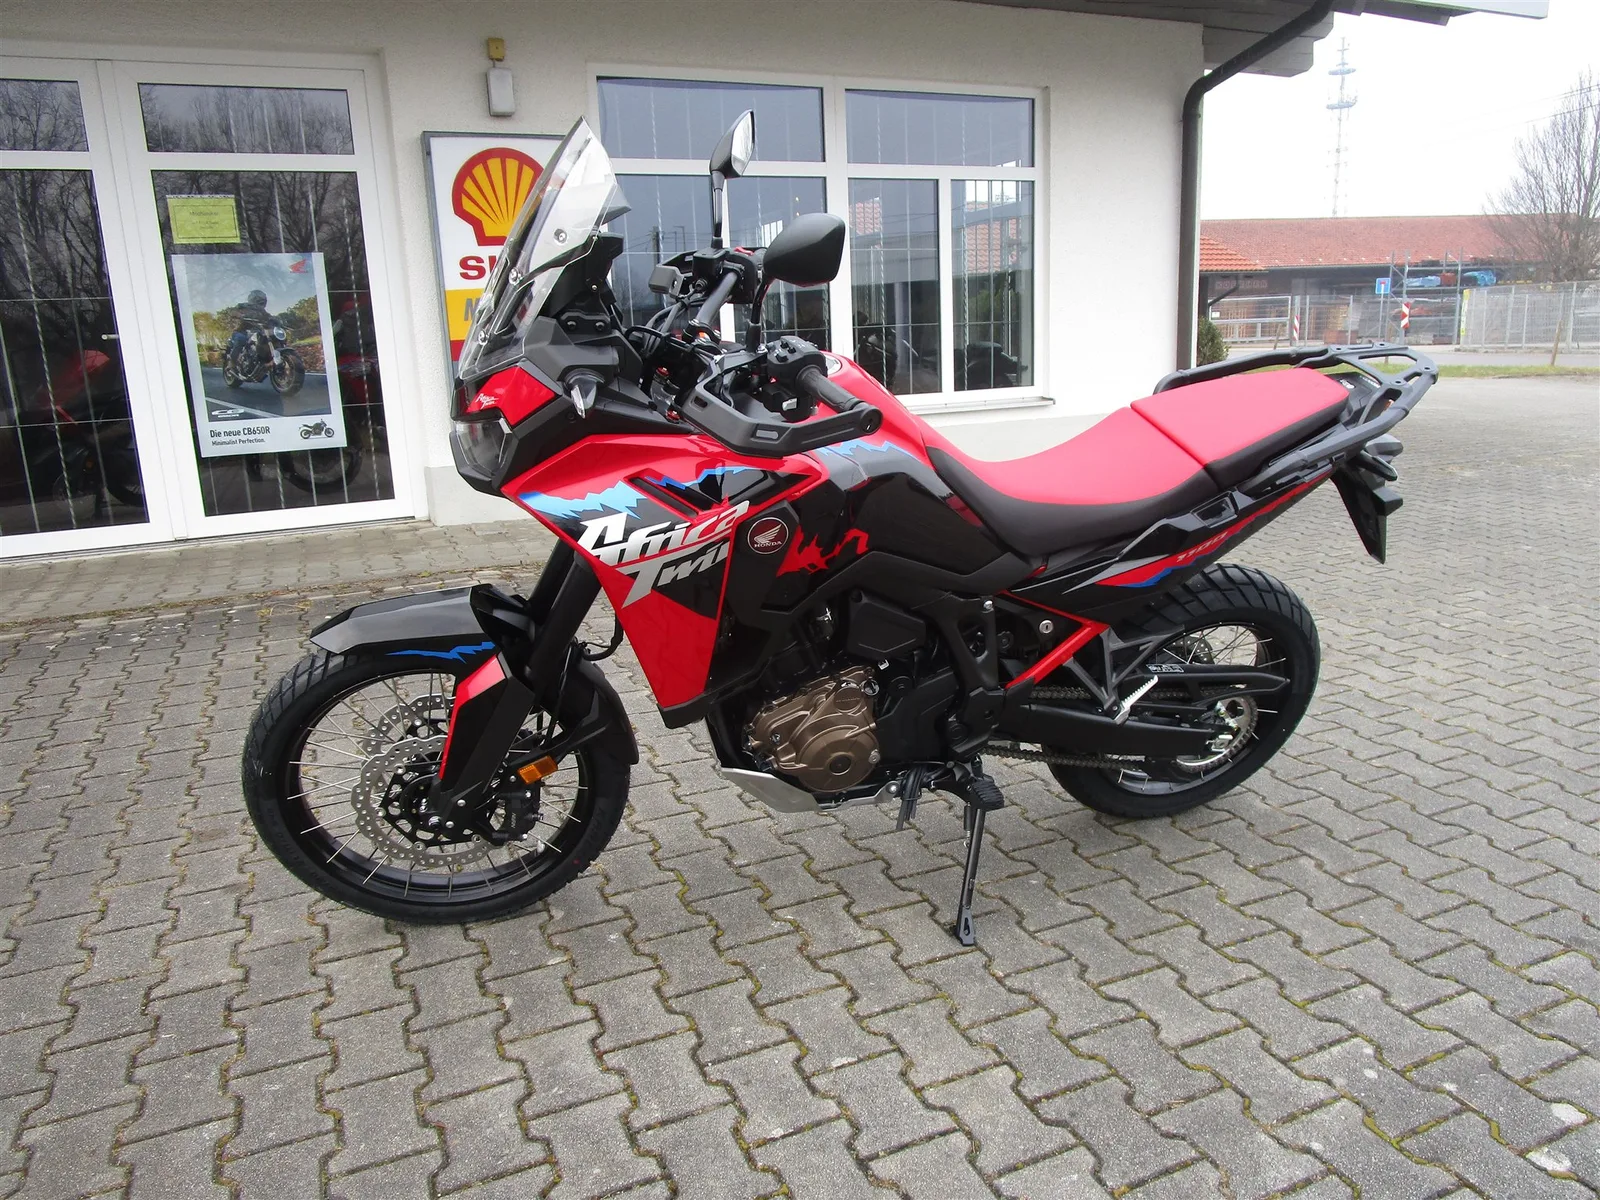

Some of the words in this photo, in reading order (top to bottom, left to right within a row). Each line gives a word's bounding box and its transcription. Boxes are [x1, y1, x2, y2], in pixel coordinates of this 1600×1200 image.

[210, 429, 222, 438] Die
[242, 426, 270, 436] CB650R
[577, 500, 750, 567] Africa
[754, 540, 783, 548] HONDA
